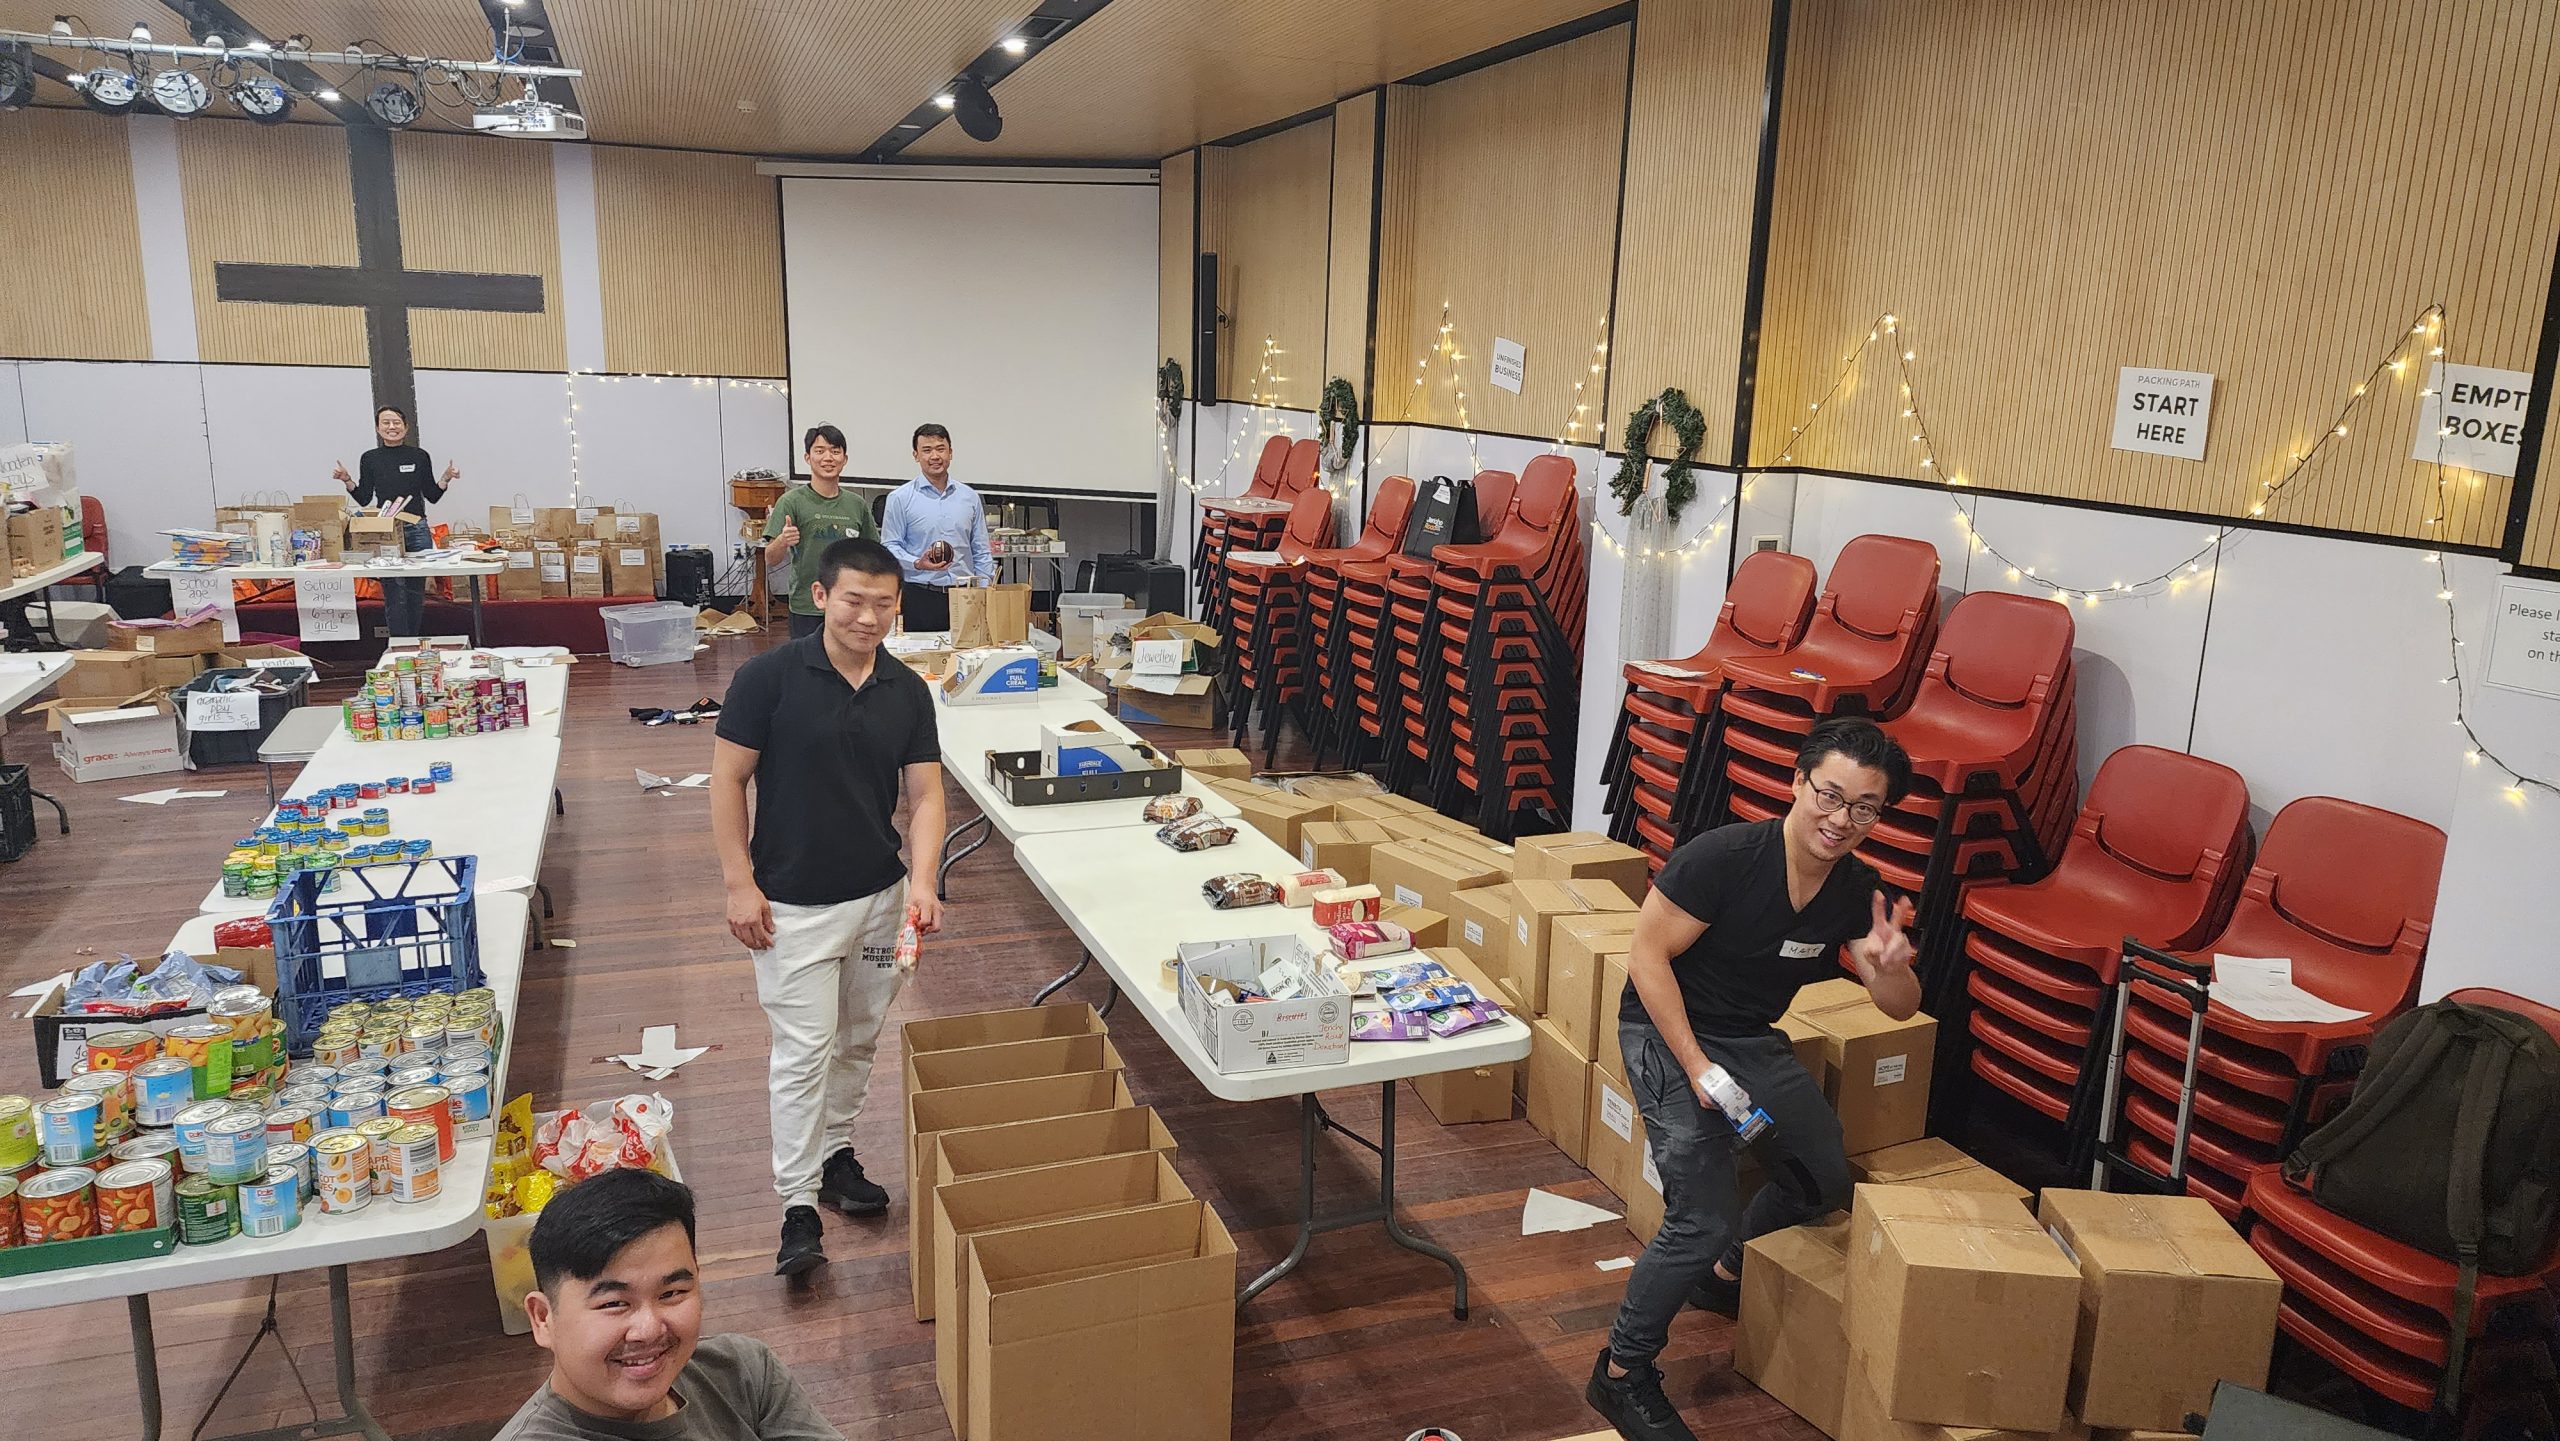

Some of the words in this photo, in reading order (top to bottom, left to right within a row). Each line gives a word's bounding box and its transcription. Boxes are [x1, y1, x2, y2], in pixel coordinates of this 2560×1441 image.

[1494, 364, 1521, 381] BUSINESS
[2137, 375, 2178, 386] PACKING
[2179, 379, 2200, 389] PATH
[2132, 392, 2199, 416] START
[2451, 382, 2531, 412] EMPT
[2136, 422, 2186, 444] HERE
[303, 578, 342, 591] School
[189, 590, 211, 605] age
[312, 593, 332, 609] age
[2509, 603, 2552, 620] Please
[2527, 649, 2545, 660] on
[124, 751, 151, 759] Always
[369, 1156, 389, 1165] APR
[319, 1175, 336, 1183] COT
